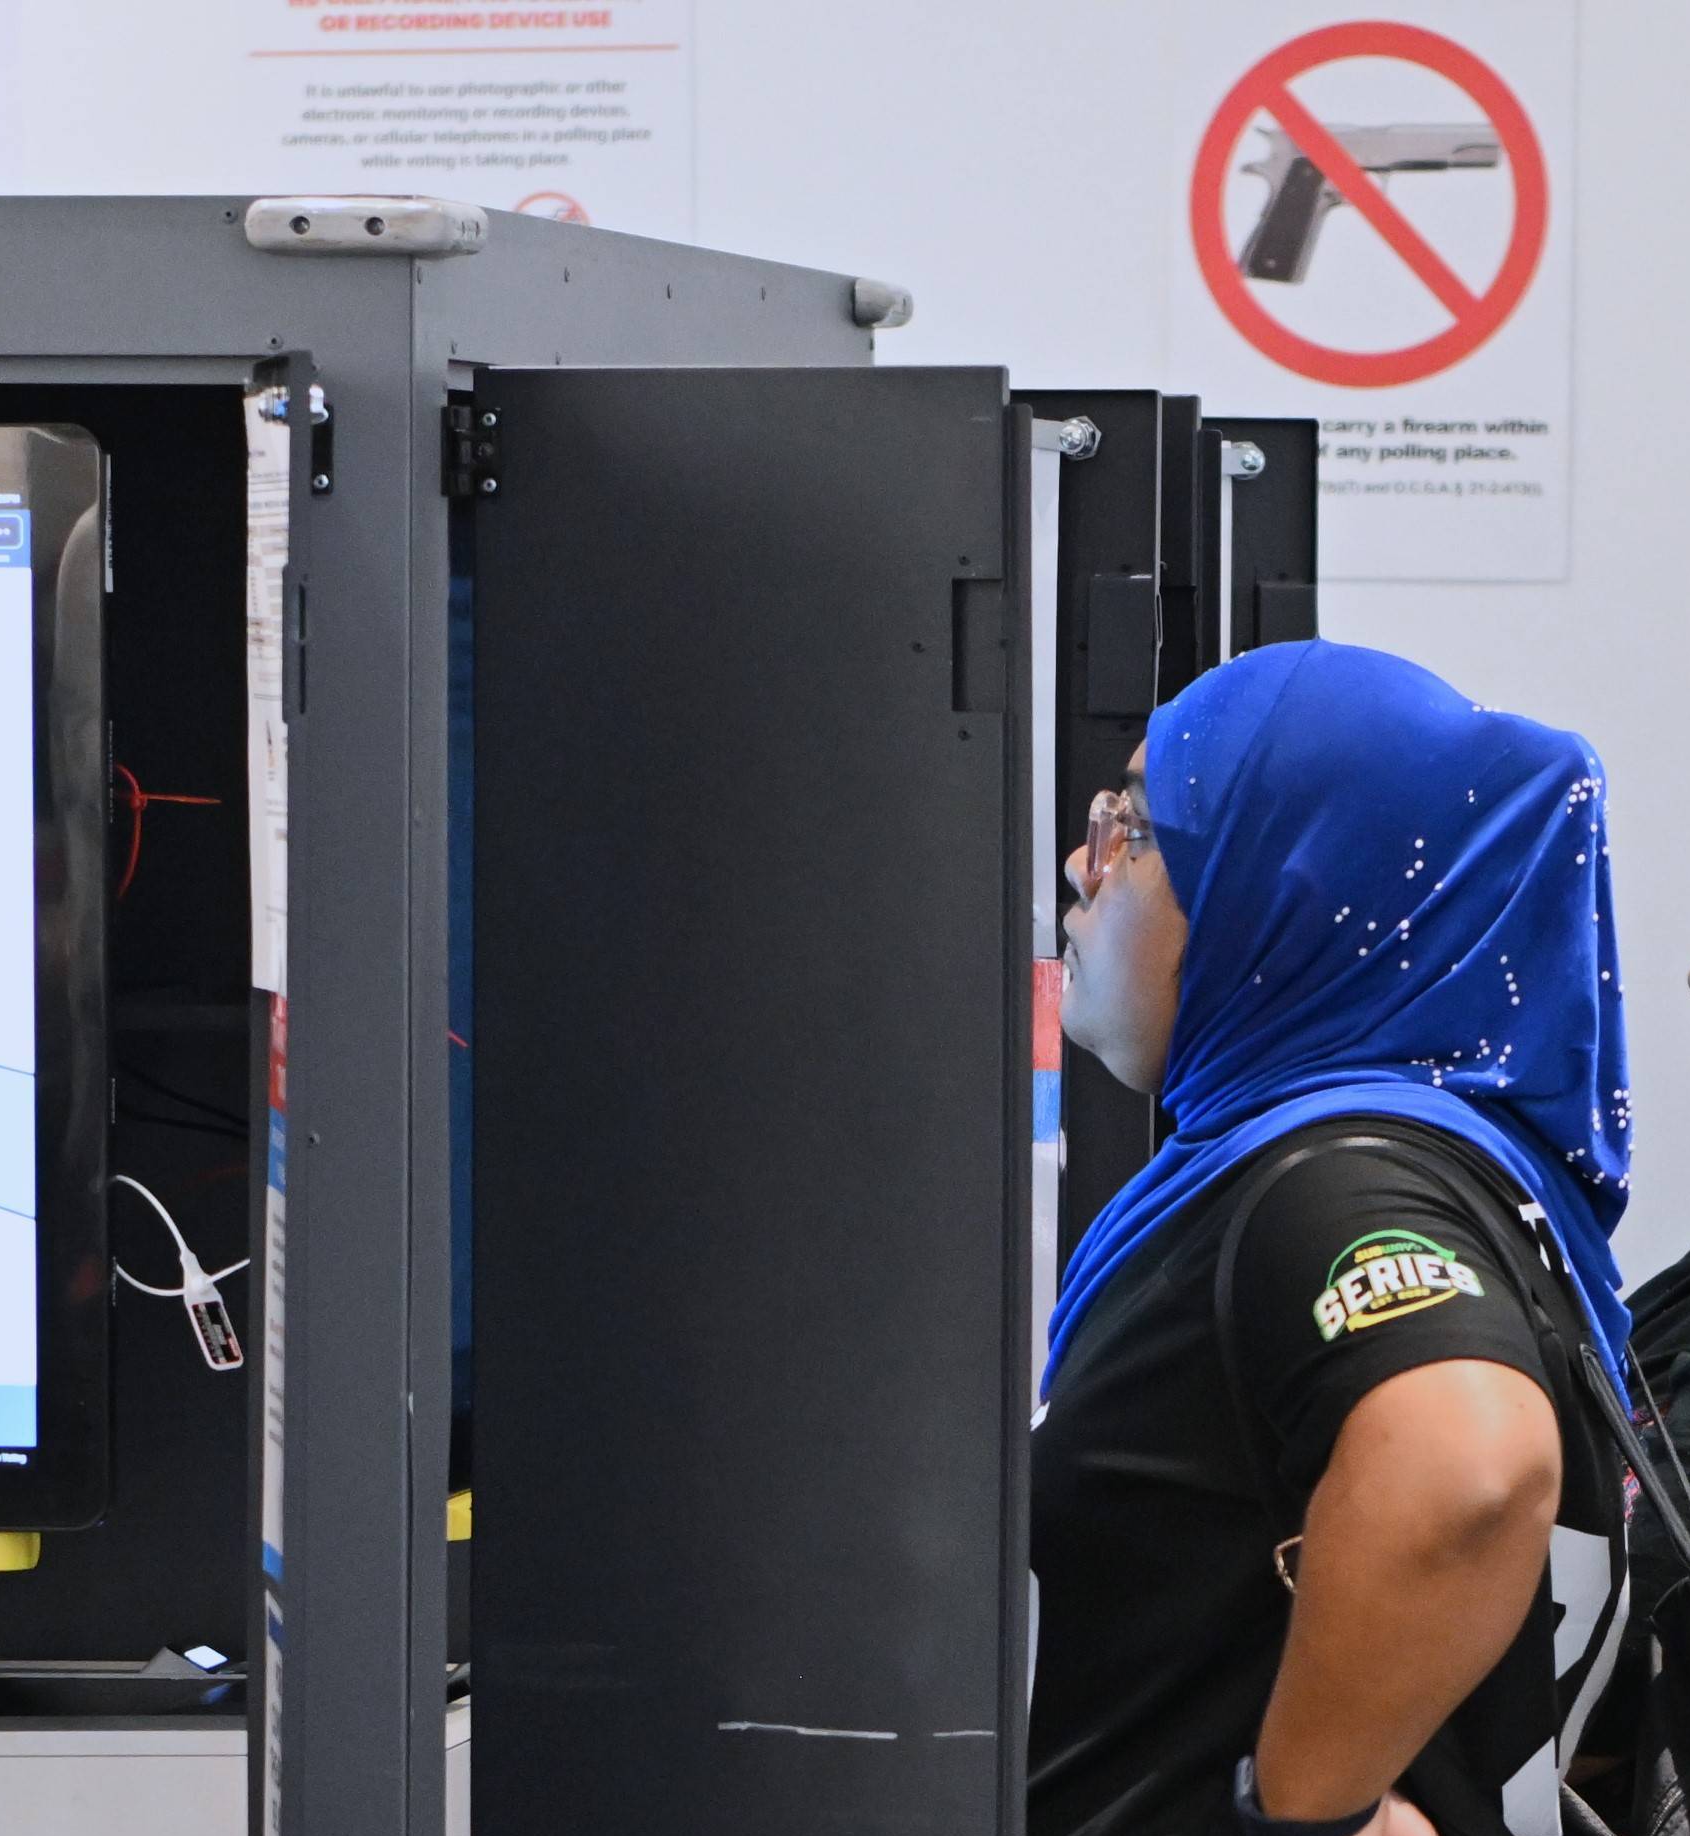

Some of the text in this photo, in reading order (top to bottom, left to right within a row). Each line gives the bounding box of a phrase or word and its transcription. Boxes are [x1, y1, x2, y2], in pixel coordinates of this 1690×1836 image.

[320, 10, 612, 31] OR RECORDING DEVICE USE
[1322, 419, 1548, 438] carry a firearm within
[1336, 446, 1372, 462] any
[1379, 444, 1446, 462] polling
[1314, 1254, 1484, 1342] SERIES
